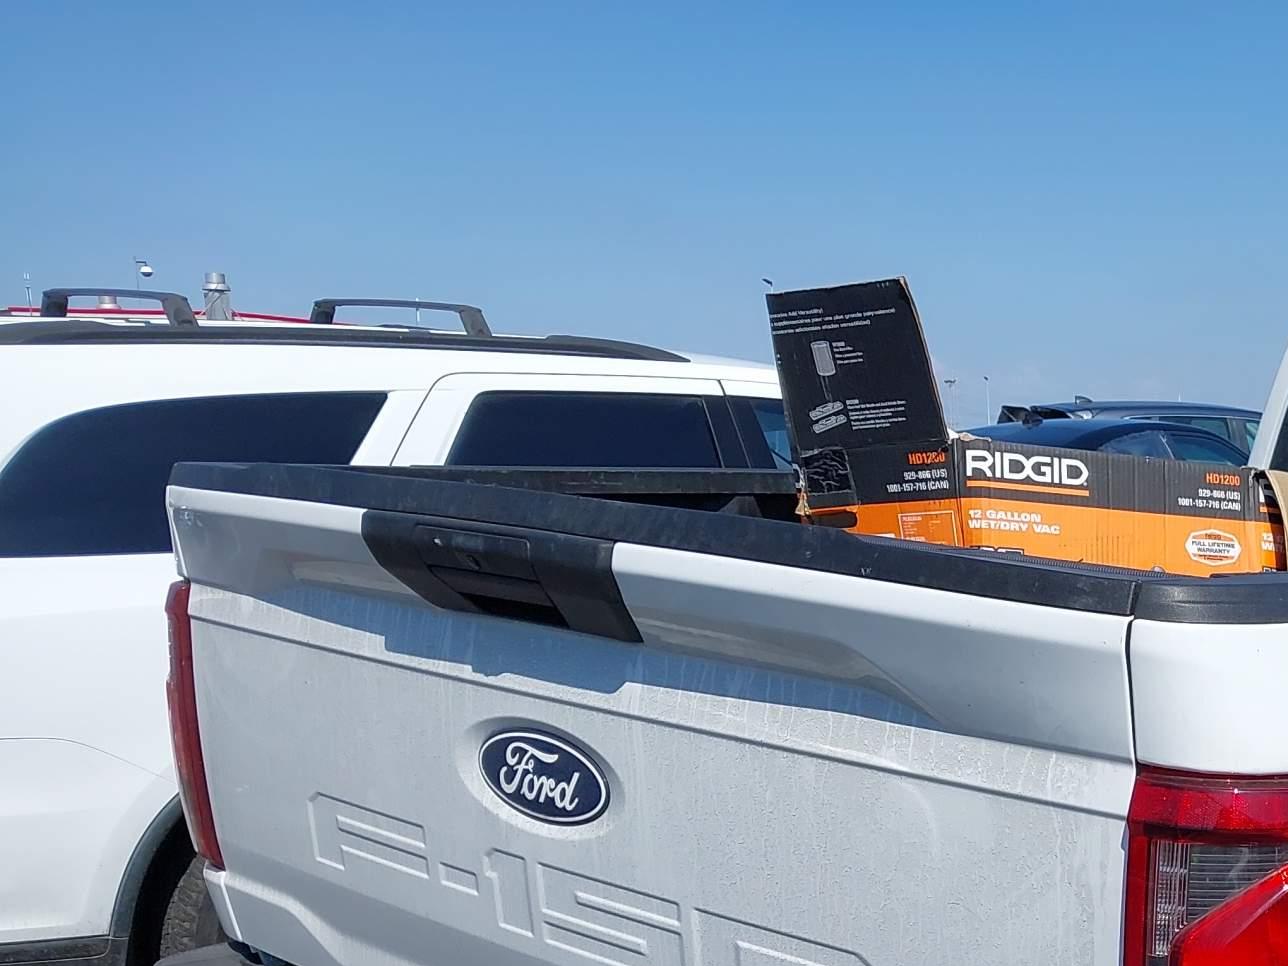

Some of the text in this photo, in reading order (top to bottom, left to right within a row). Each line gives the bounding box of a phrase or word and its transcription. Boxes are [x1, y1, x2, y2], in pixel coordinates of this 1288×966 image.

[931, 468, 948, 479] (US)
[965, 449, 1089, 486] RIDGID
[927, 479, 949, 491] (CAN)
[1205, 472, 1241, 486] HD1200
[1226, 490, 1241, 501] (US)
[1220, 500, 1241, 511] (CAN)
[968, 510, 1042, 523] 12 GALLON
[968, 520, 1061, 535] WET/DRY VAC
[1196, 547, 1231, 555] WARRANTY
[1207, 541, 1236, 549] LIFETIME
[500, 742, 580, 811] Ford
